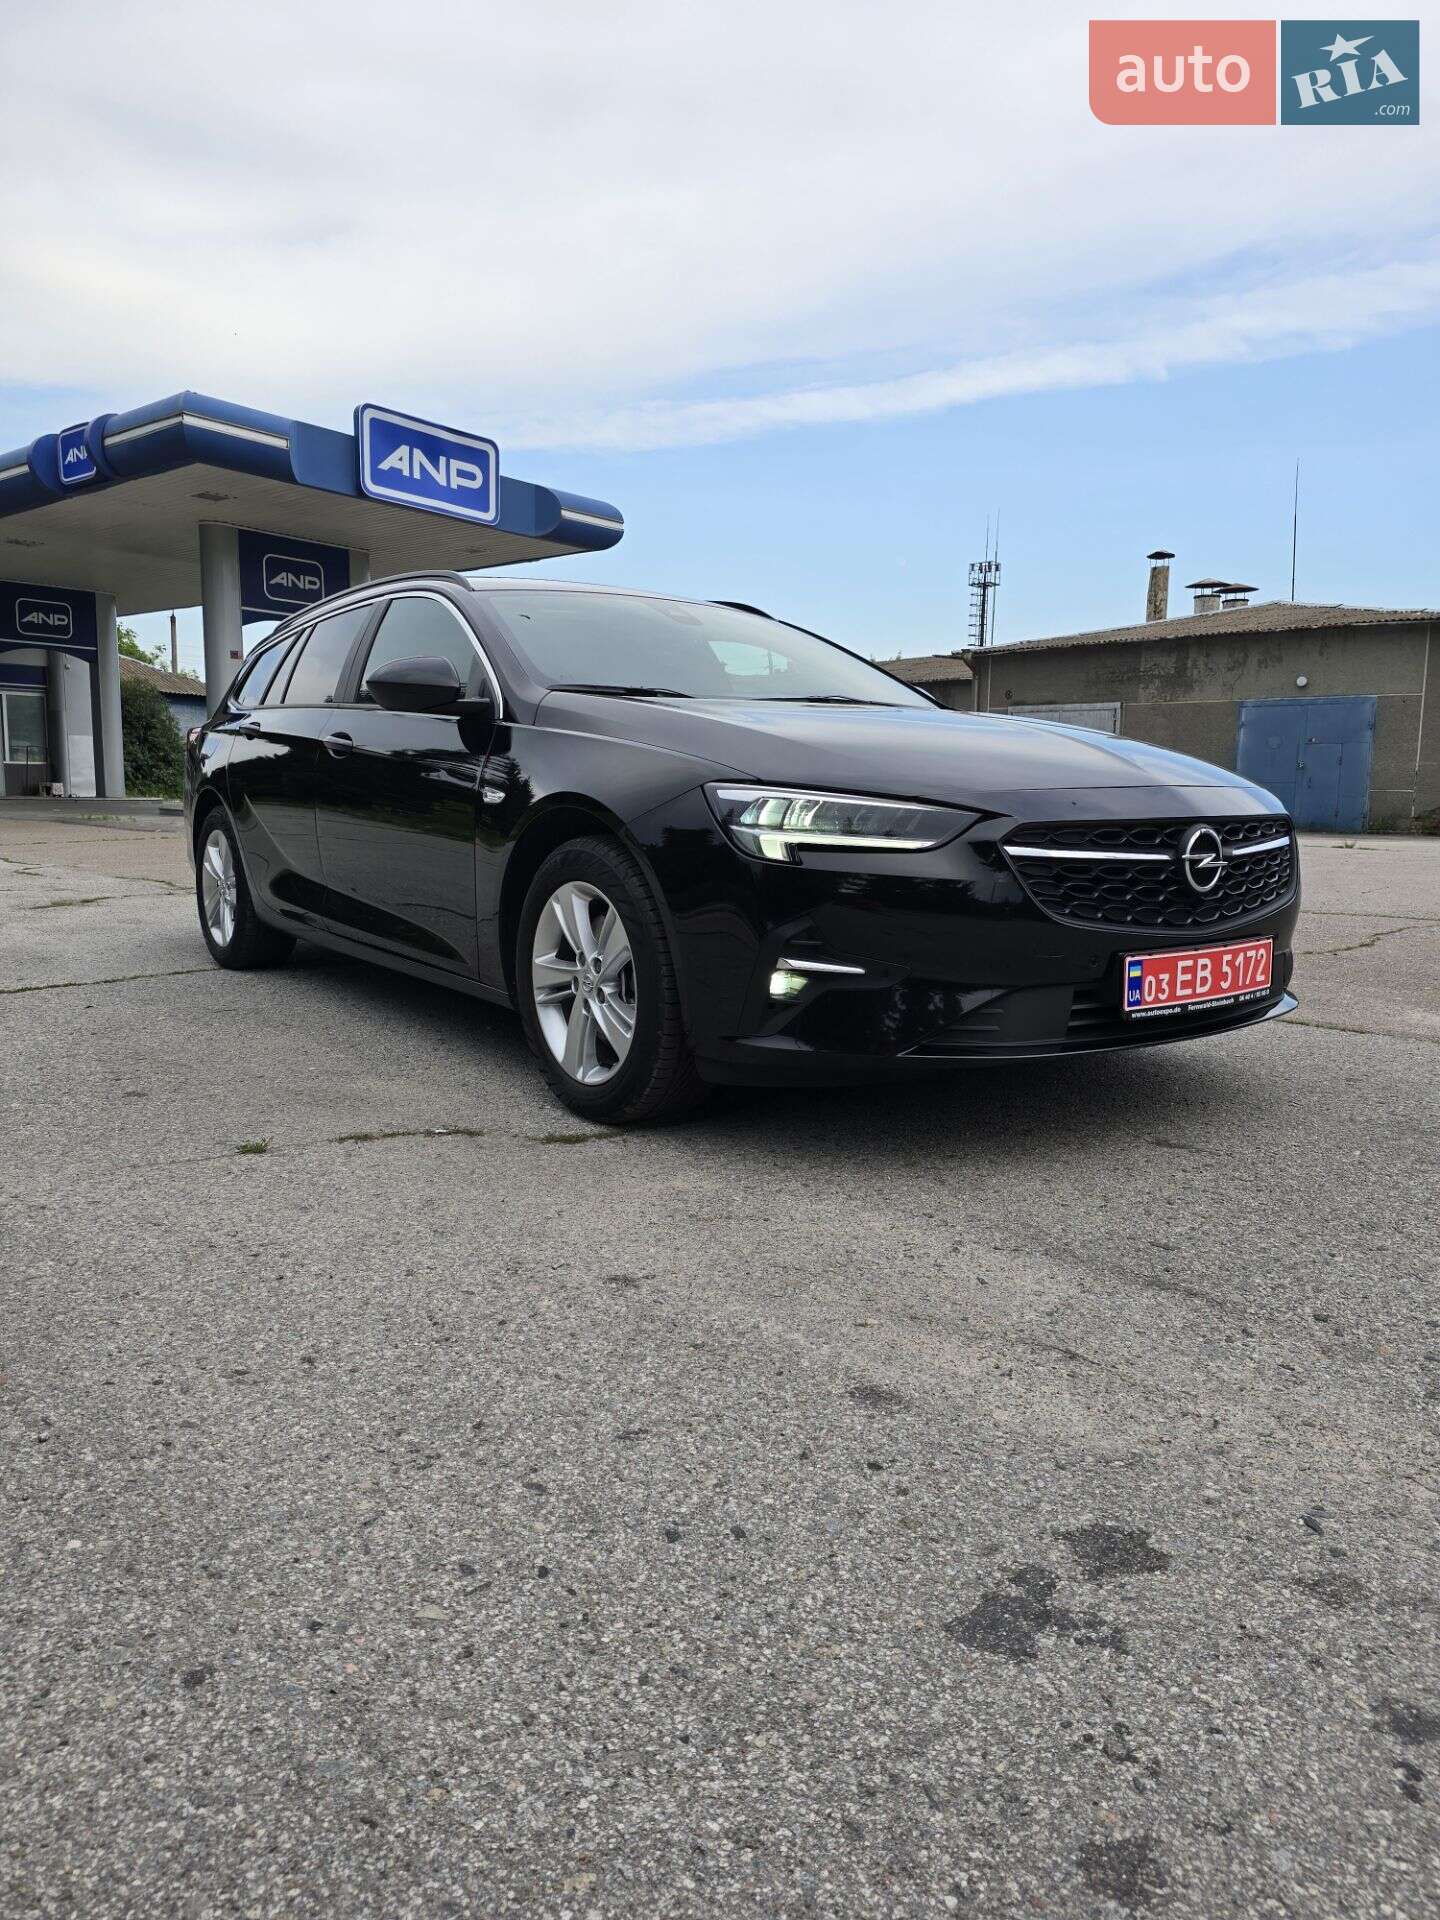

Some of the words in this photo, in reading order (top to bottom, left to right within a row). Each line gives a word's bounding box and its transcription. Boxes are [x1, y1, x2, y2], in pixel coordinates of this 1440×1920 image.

[377, 444, 484, 490] ANP
[269, 571, 321, 590] ANP
[21, 611, 69, 626] ANP
[1144, 974, 1169, 1001] 03
[1176, 958, 1212, 996] EB
[1219, 949, 1265, 989] 5172
[1129, 990, 1141, 1002] UA
